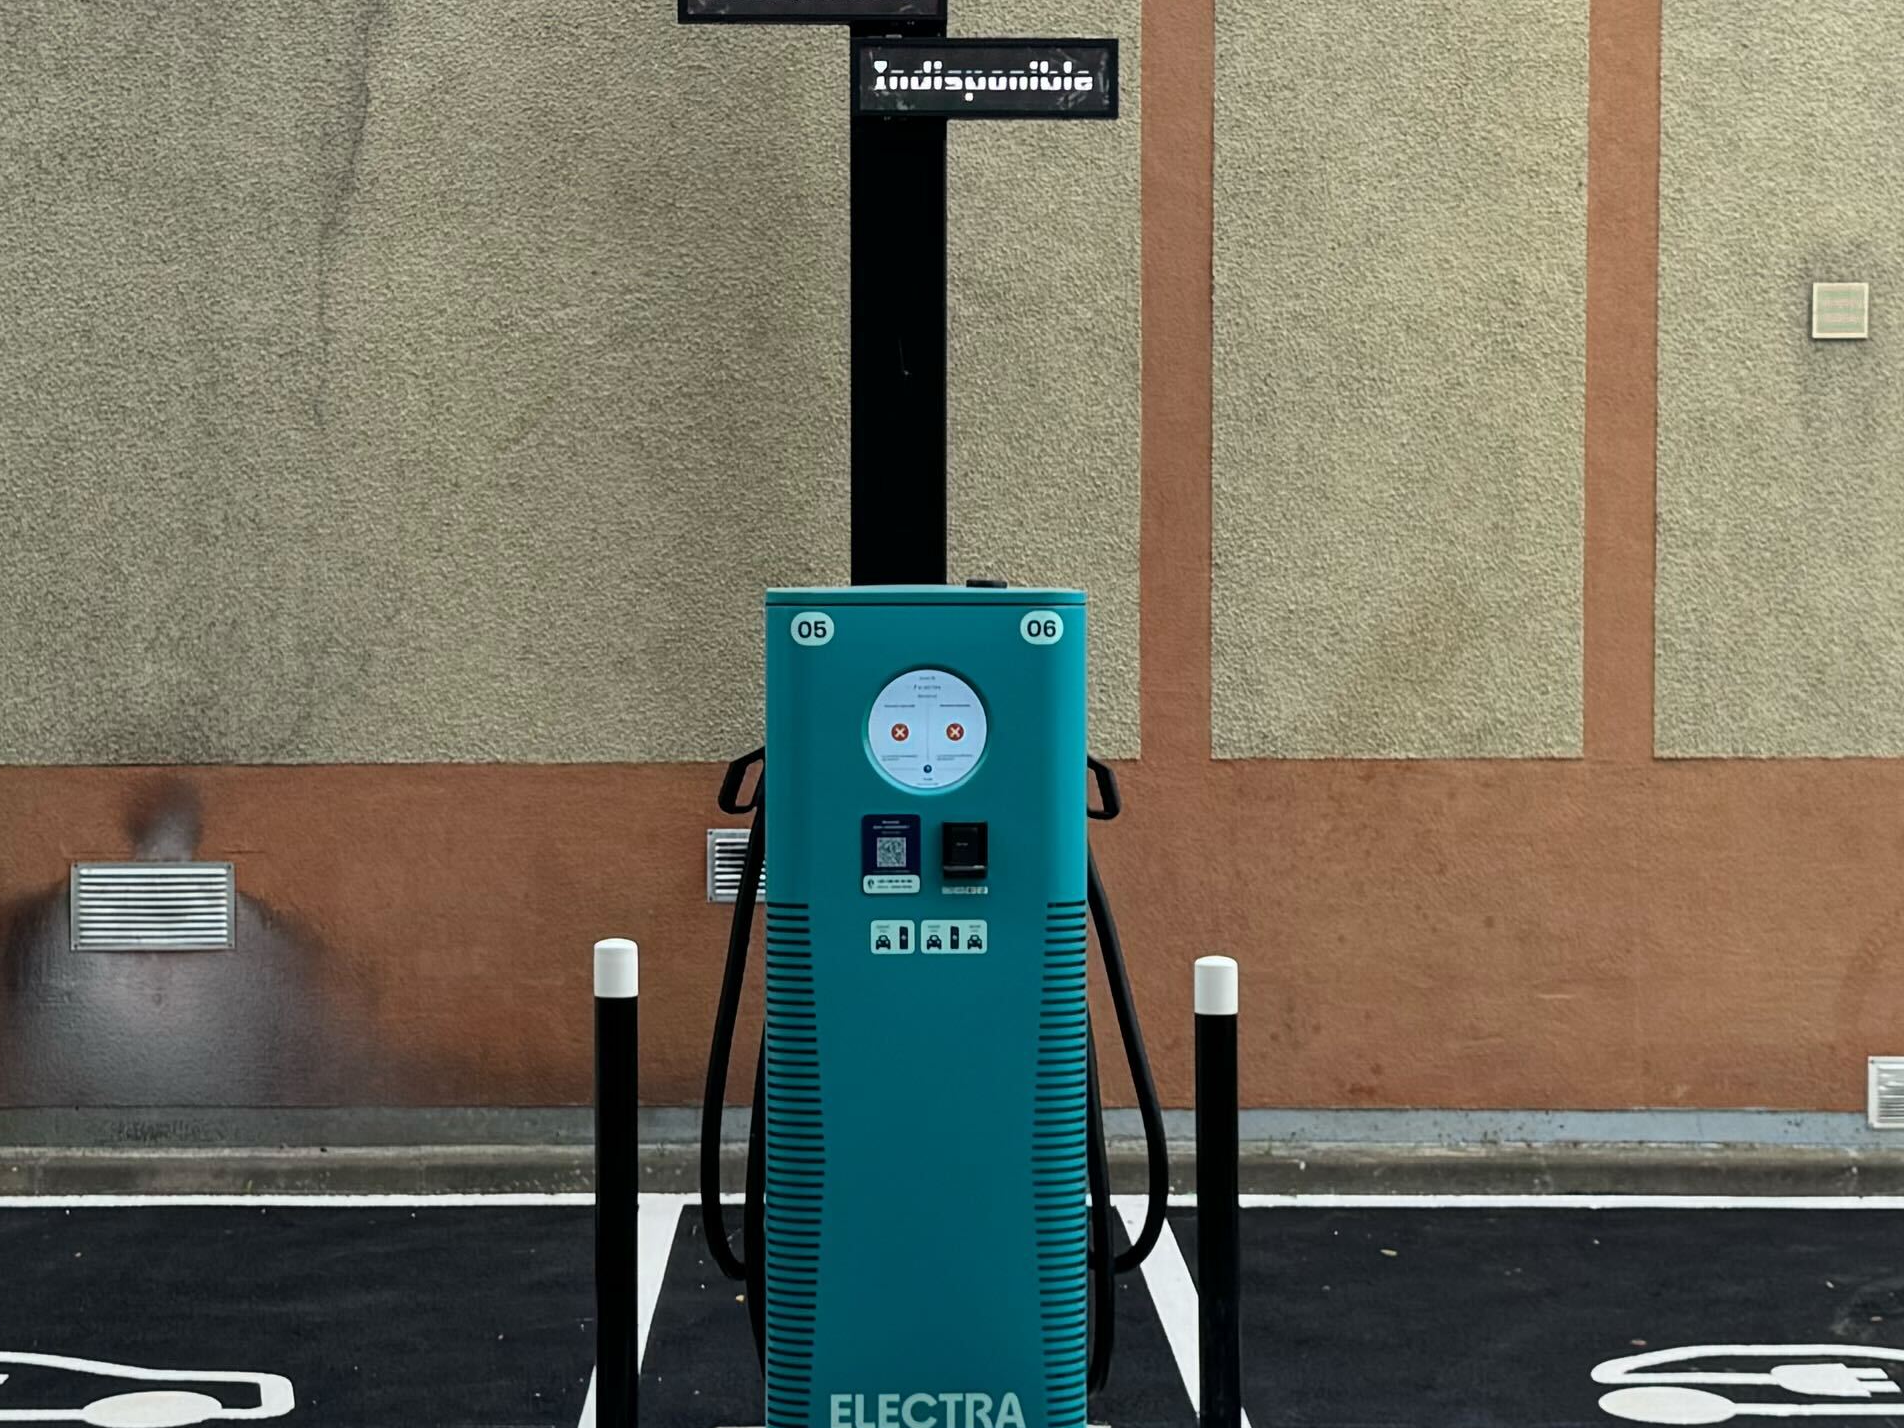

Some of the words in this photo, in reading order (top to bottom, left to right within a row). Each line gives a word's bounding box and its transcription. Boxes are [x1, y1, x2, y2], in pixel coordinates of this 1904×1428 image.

[873, 60, 1093, 101] Indisponible
[797, 620, 827, 639] 05
[1027, 619, 1057, 638] 06
